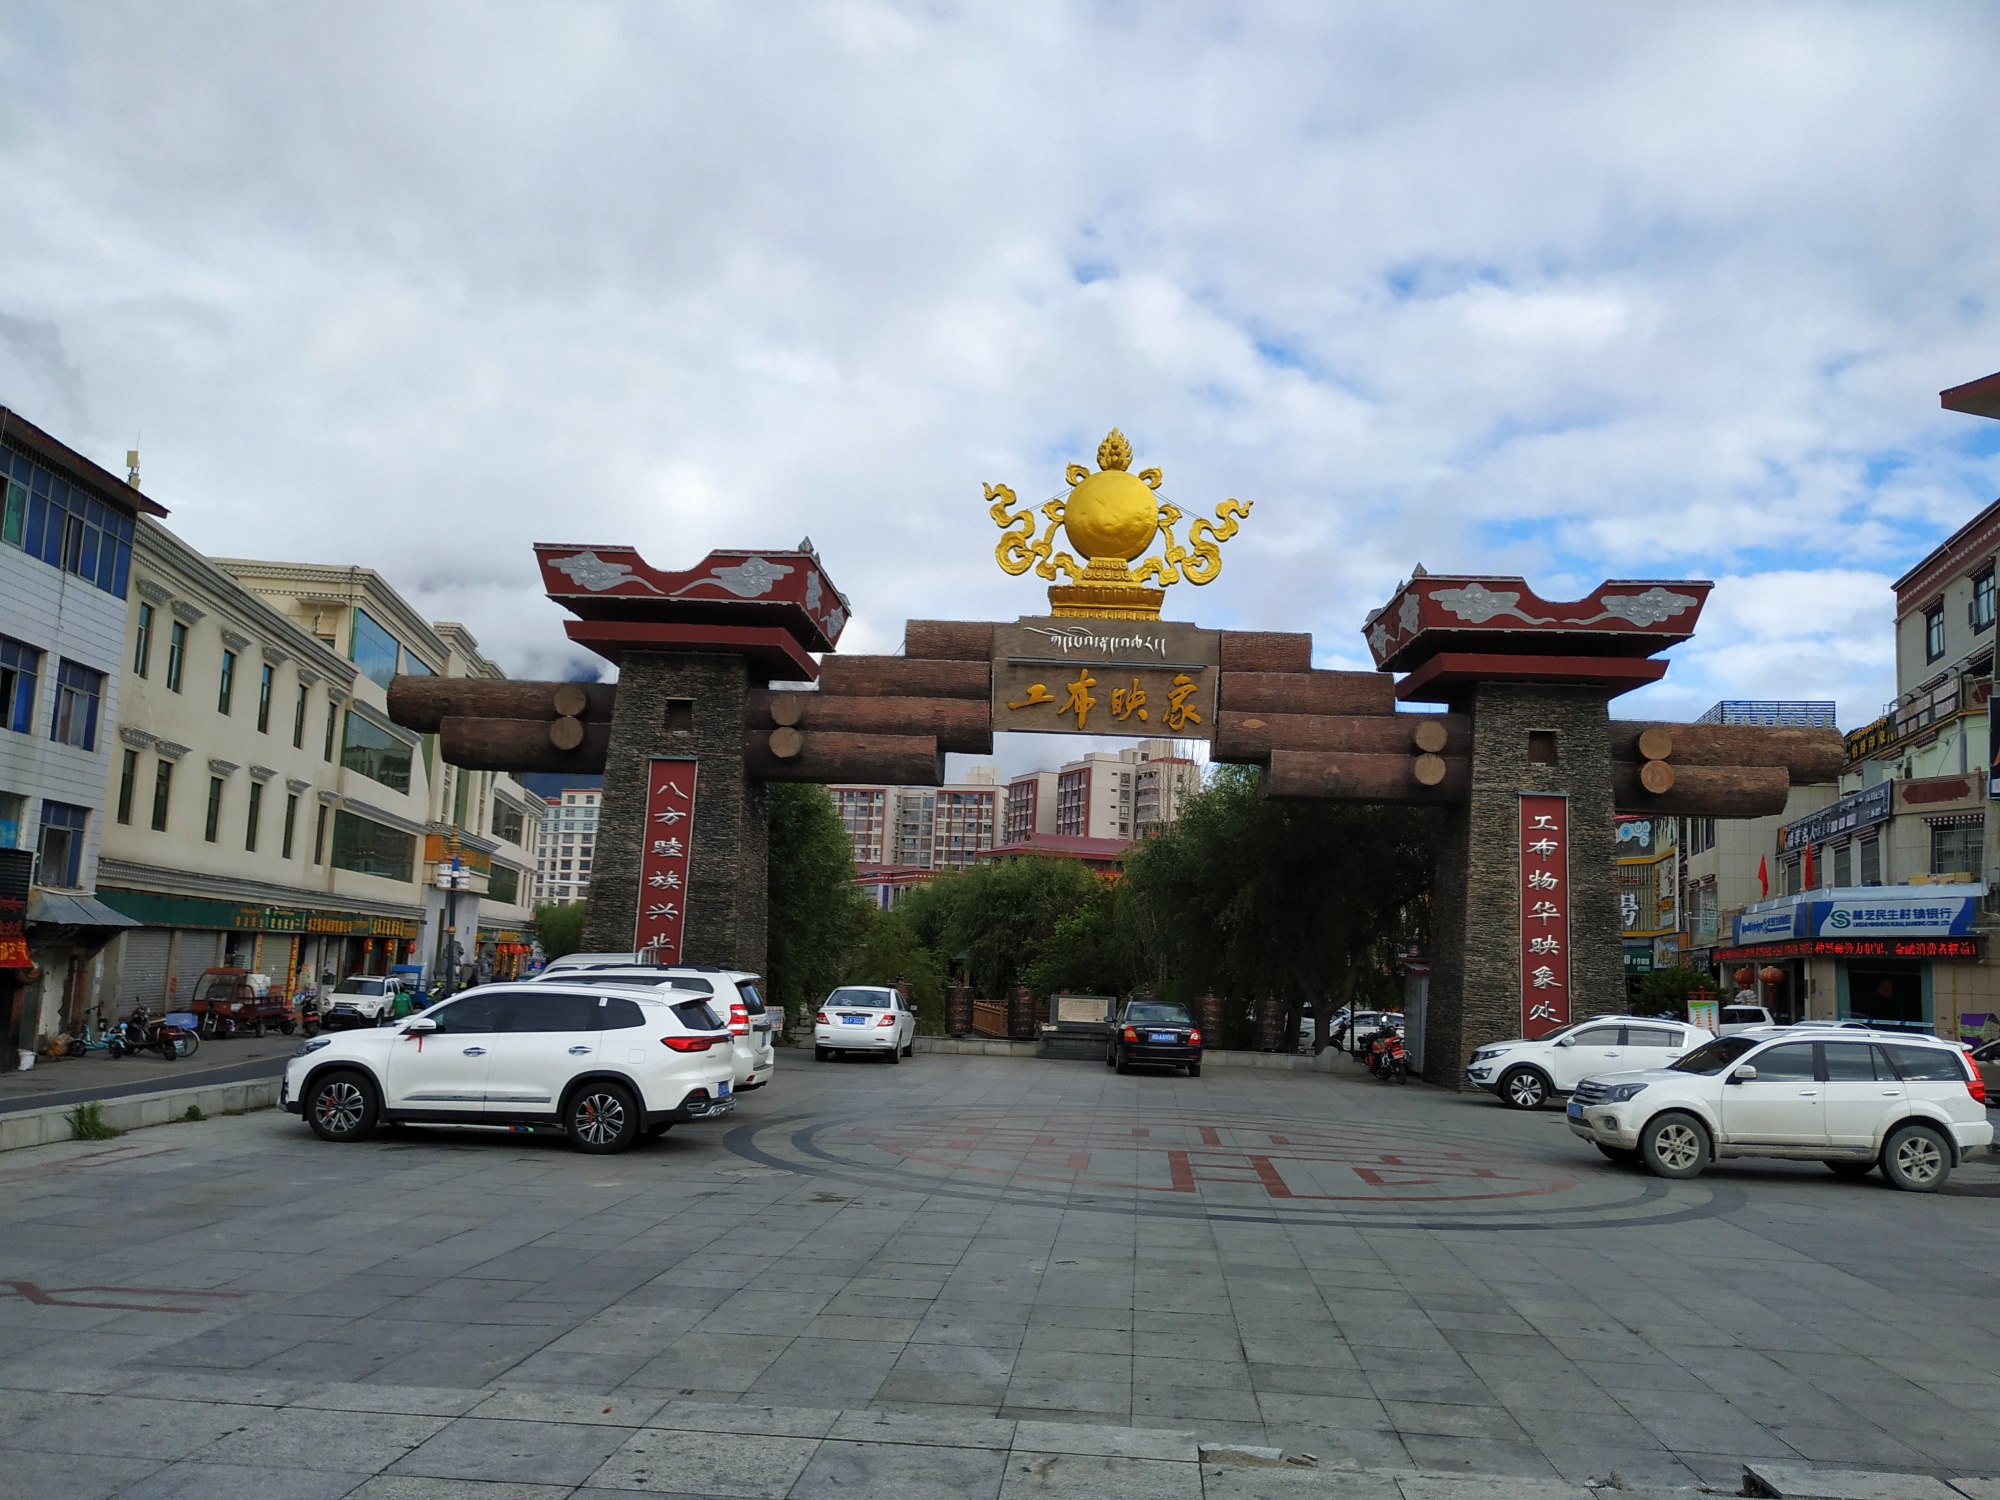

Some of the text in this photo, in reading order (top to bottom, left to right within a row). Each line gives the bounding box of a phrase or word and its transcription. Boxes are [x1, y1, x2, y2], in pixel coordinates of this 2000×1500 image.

[645, 781, 690, 964] 八方睦族兴业
[1525, 815, 1563, 1023] 工布物华映象处
[1852, 907, 1953, 920] 林芝民生村镇银行
